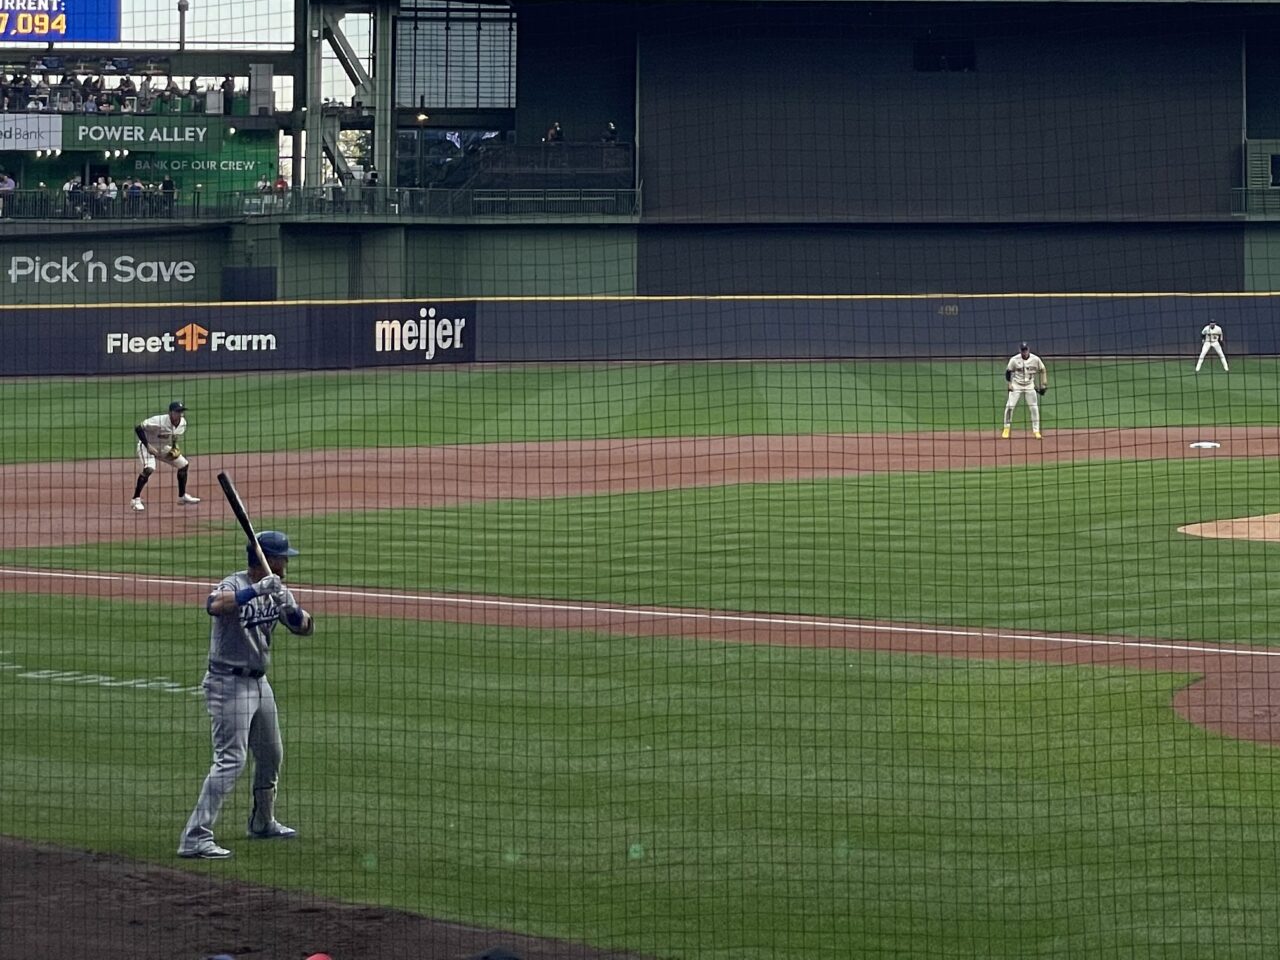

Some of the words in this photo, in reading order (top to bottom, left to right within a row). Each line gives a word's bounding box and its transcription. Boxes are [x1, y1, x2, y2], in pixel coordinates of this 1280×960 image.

[15, 127, 44, 140] Bank
[78, 125, 144, 141] POWER
[149, 127, 207, 142] ALLEY
[135, 160, 168, 171] BANK
[171, 160, 188, 171] OF
[191, 161, 217, 171] OUR
[220, 160, 255, 171] CREW
[113, 256, 196, 282] Save
[937, 304, 959, 316] 400
[107, 332, 175, 354] Fleet
[211, 330, 276, 352] Farm
[375, 308, 466, 360] meijer
